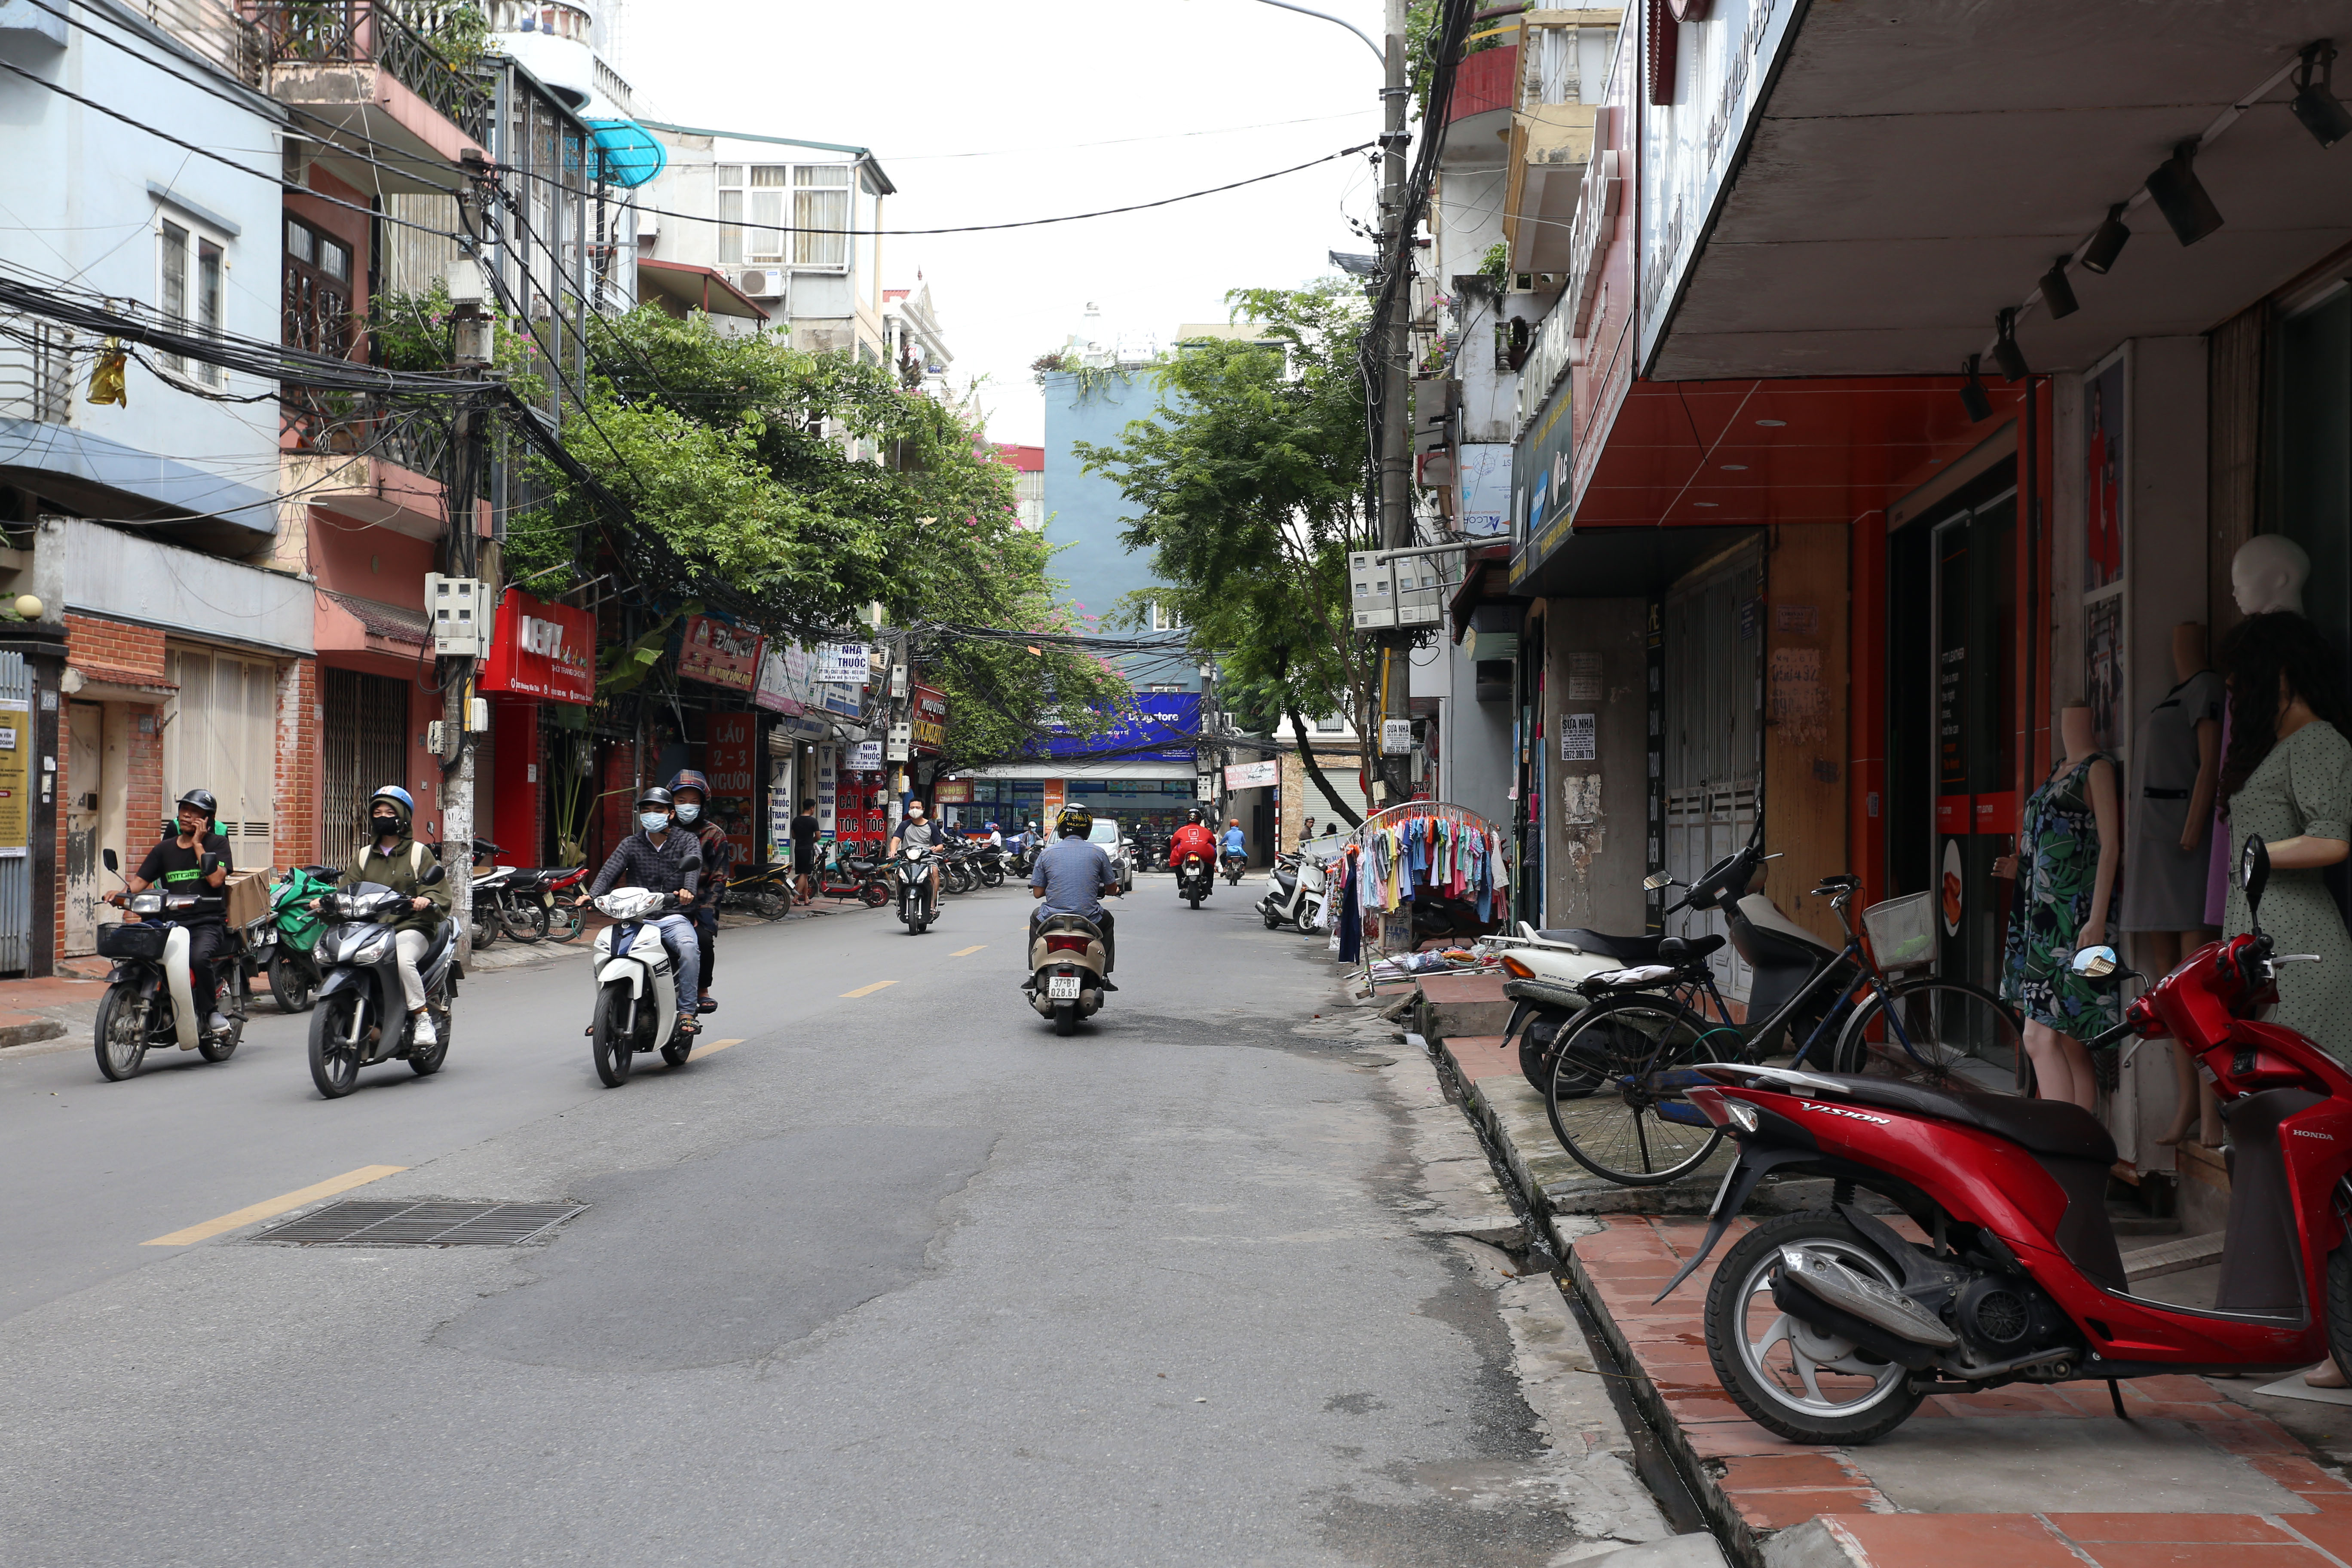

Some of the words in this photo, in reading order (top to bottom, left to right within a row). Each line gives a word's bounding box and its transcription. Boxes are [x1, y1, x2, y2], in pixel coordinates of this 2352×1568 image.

[1560, 453, 1568, 486] LG
[522, 616, 564, 659] LEVY
[1949, 647, 1965, 662] LEATHER
[838, 655, 866, 668] THUỐC
[43, 694, 55, 707] 275
[1387, 722, 1397, 733] SỬA
[1399, 723, 1409, 733] NHÀ
[1563, 715, 1577, 730] SỬA
[1579, 717, 1594, 729] NHÀ
[863, 742, 877, 750] NHÀ
[714, 750, 723, 767] 2
[739, 750, 747, 767] 3
[860, 750, 880, 760] THUỐC
[1564, 750, 1575, 759] 0972
[1576, 750, 1584, 759] 398
[1585, 749, 1594, 759] 776
[821, 766, 832, 777] NHÀ
[708, 771, 751, 790] NGƯỜI
[818, 779, 835, 791] THUỐC
[775, 787, 786, 796] NHÀ
[937, 784, 947, 795] BÚN
[956, 783, 968, 795] HUẾ
[772, 798, 790, 807] THUỐC
[818, 795, 834, 805] TRANG
[839, 791, 858, 809] CẮT
[772, 811, 789, 819] TRANG
[821, 809, 831, 818] ANH
[775, 823, 786, 831] ANH
[839, 815, 858, 833] TÓC
[866, 815, 884, 833] TÓC
[1054, 979, 1075, 988] 37-B1
[1051, 988, 1077, 997] 028.61
[1800, 1101, 1891, 1125] VISION
[2293, 1129, 2334, 1141] HONDA
